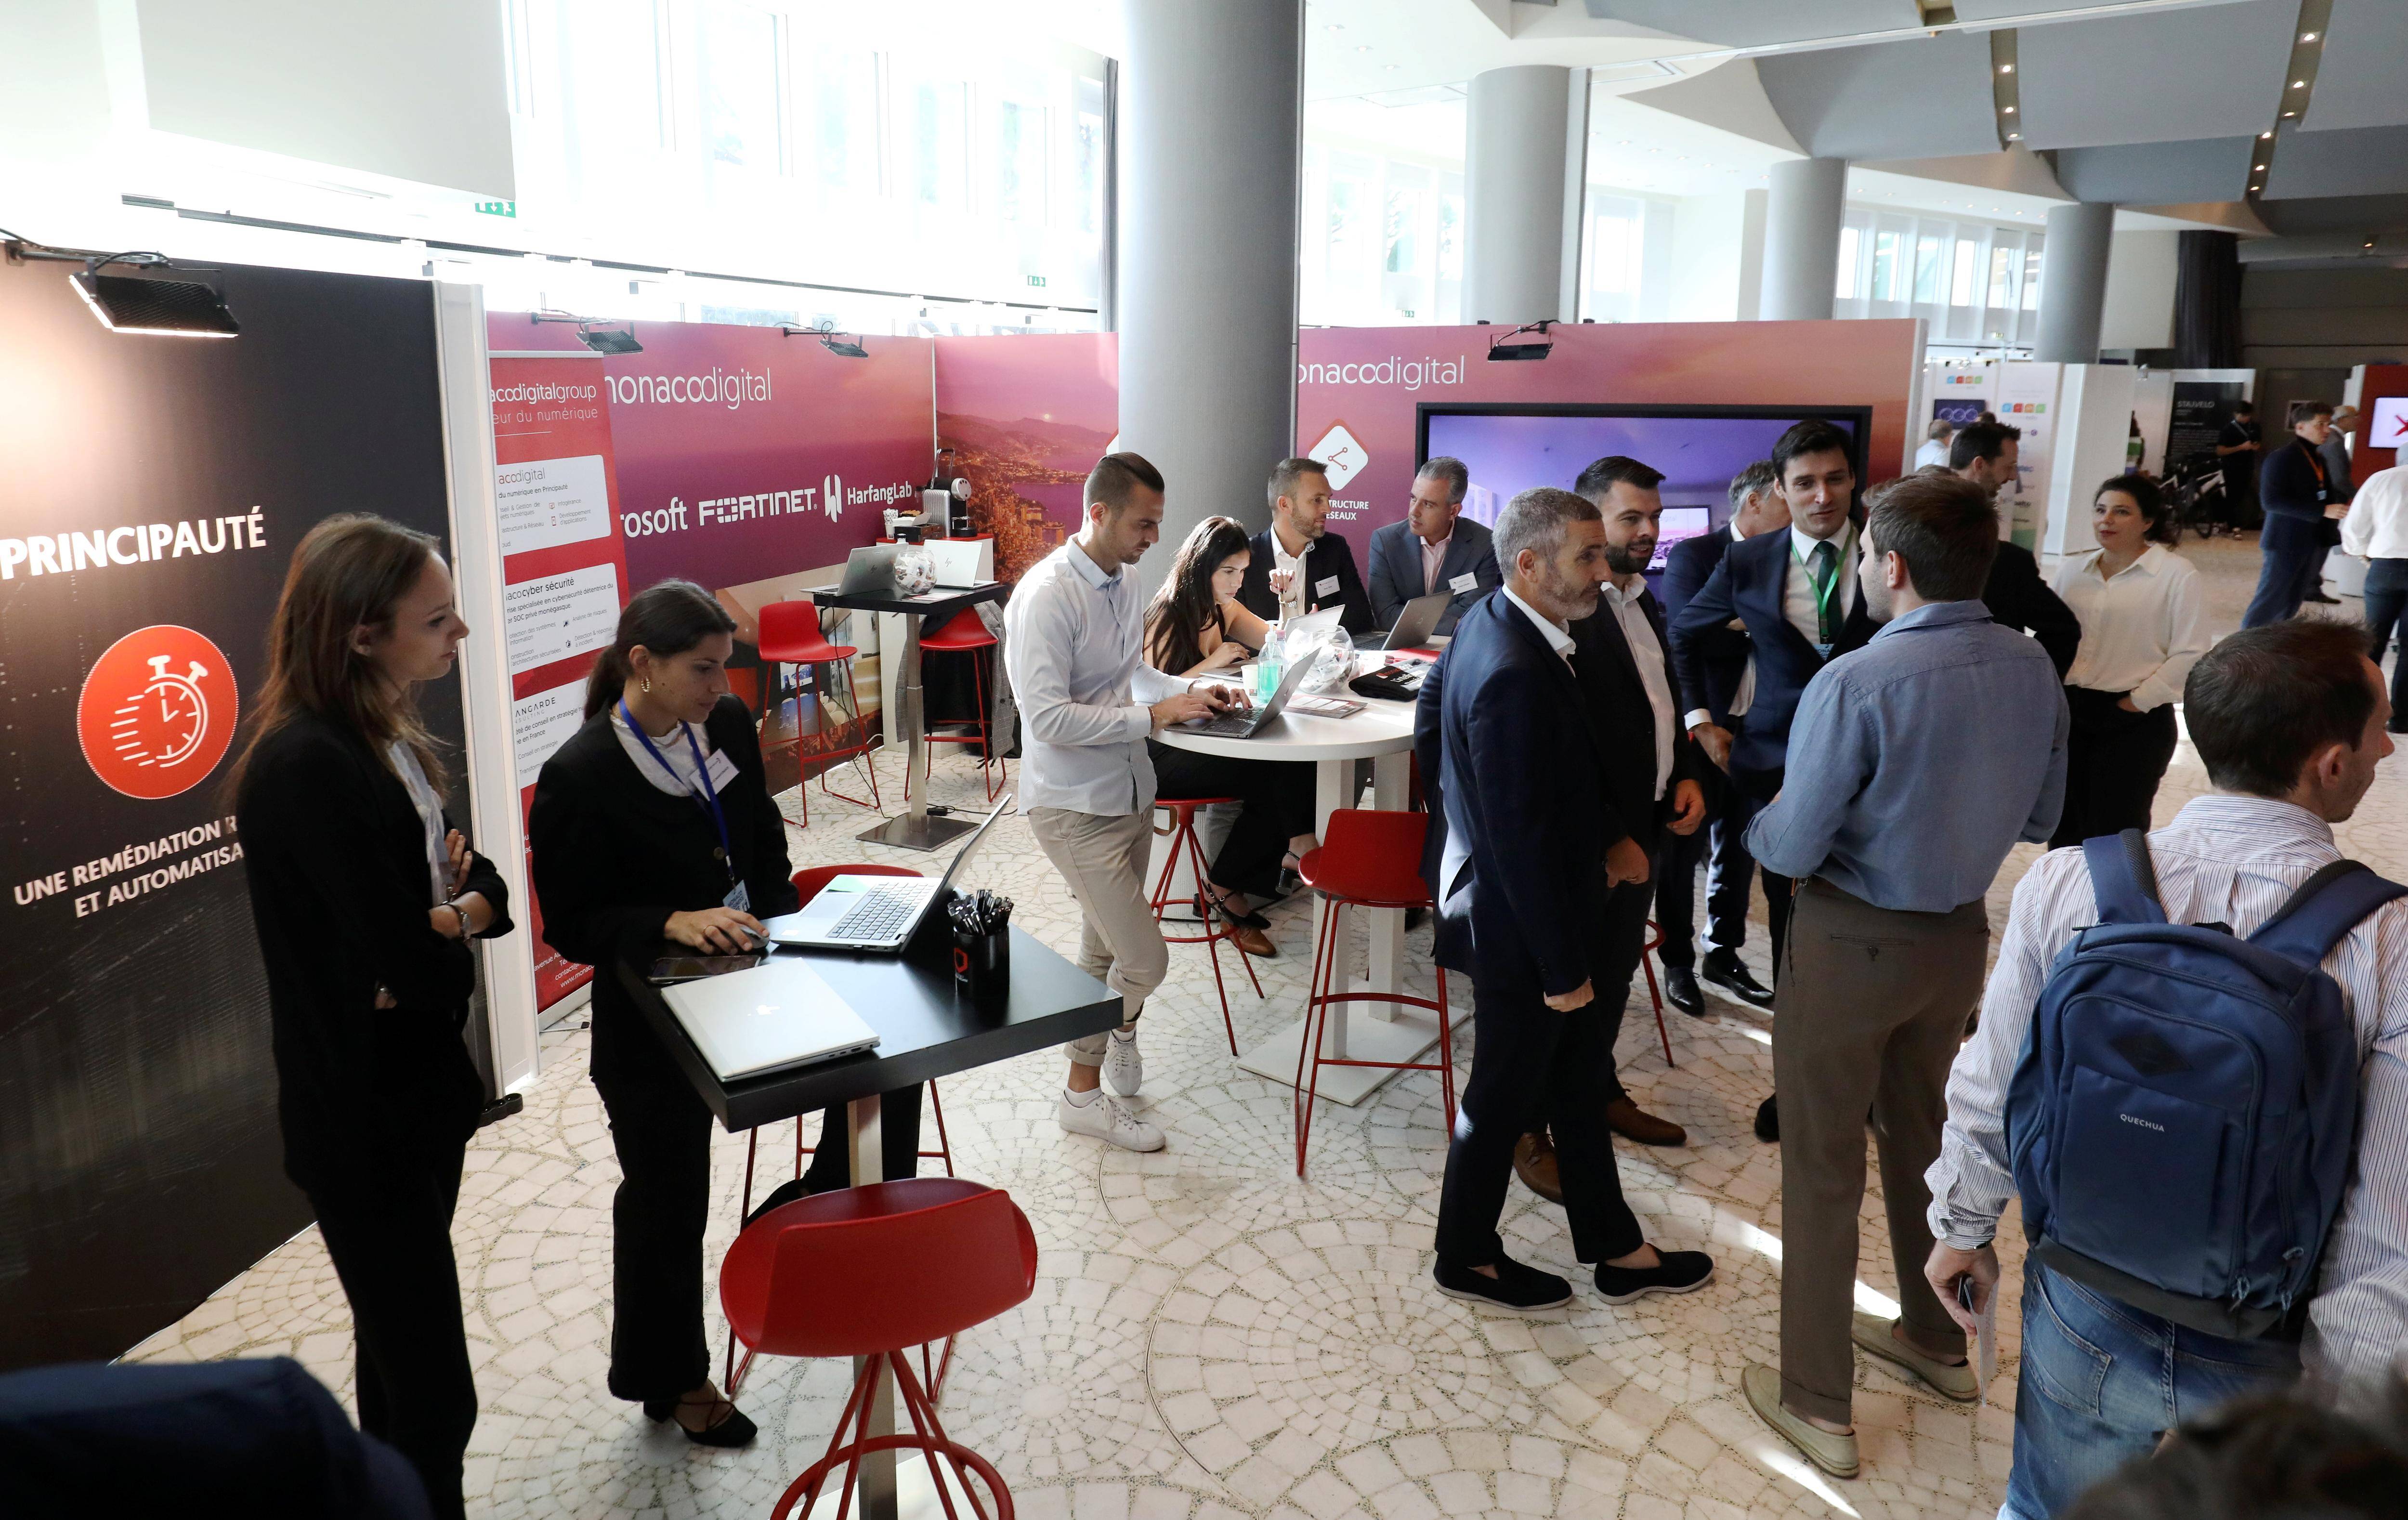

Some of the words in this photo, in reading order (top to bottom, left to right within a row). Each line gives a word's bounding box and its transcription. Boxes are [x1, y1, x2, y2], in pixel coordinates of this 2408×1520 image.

[517, 410, 532, 422] du
[537, 407, 598, 421] numérique
[499, 467, 545, 484] acodigital
[847, 481, 912, 505] HarfangLab
[559, 509, 591, 518] Développement
[0, 505, 266, 579] PRINCIPAUTÉ
[545, 577, 574, 591] sécurité
[518, 600, 543, 612] spécialisée
[552, 590, 582, 603] cybersécurité
[583, 585, 606, 594] détentrice
[513, 614, 524, 622] SOC
[525, 611, 537, 620] privé
[536, 622, 556, 631] systèmes
[539, 648, 562, 658] sécurisées
[532, 717, 549, 729] conseil
[557, 708, 578, 720] stratégie
[530, 730, 546, 739] France
[518, 749, 533, 760] Conseil
[540, 740, 558, 751] stratégie
[519, 761, 545, 775] Transforma
[13, 871, 68, 905] UNE
[72, 820, 221, 887] REMÉDIATION
[74, 891, 101, 918] ET
[107, 842, 244, 907] AUTOMATISA
[534, 957, 553, 971] avenue
[555, 963, 581, 981] contact@
[560, 965, 595, 987] www.monaco
[2120, 1114, 2165, 1132] QUECHUA
